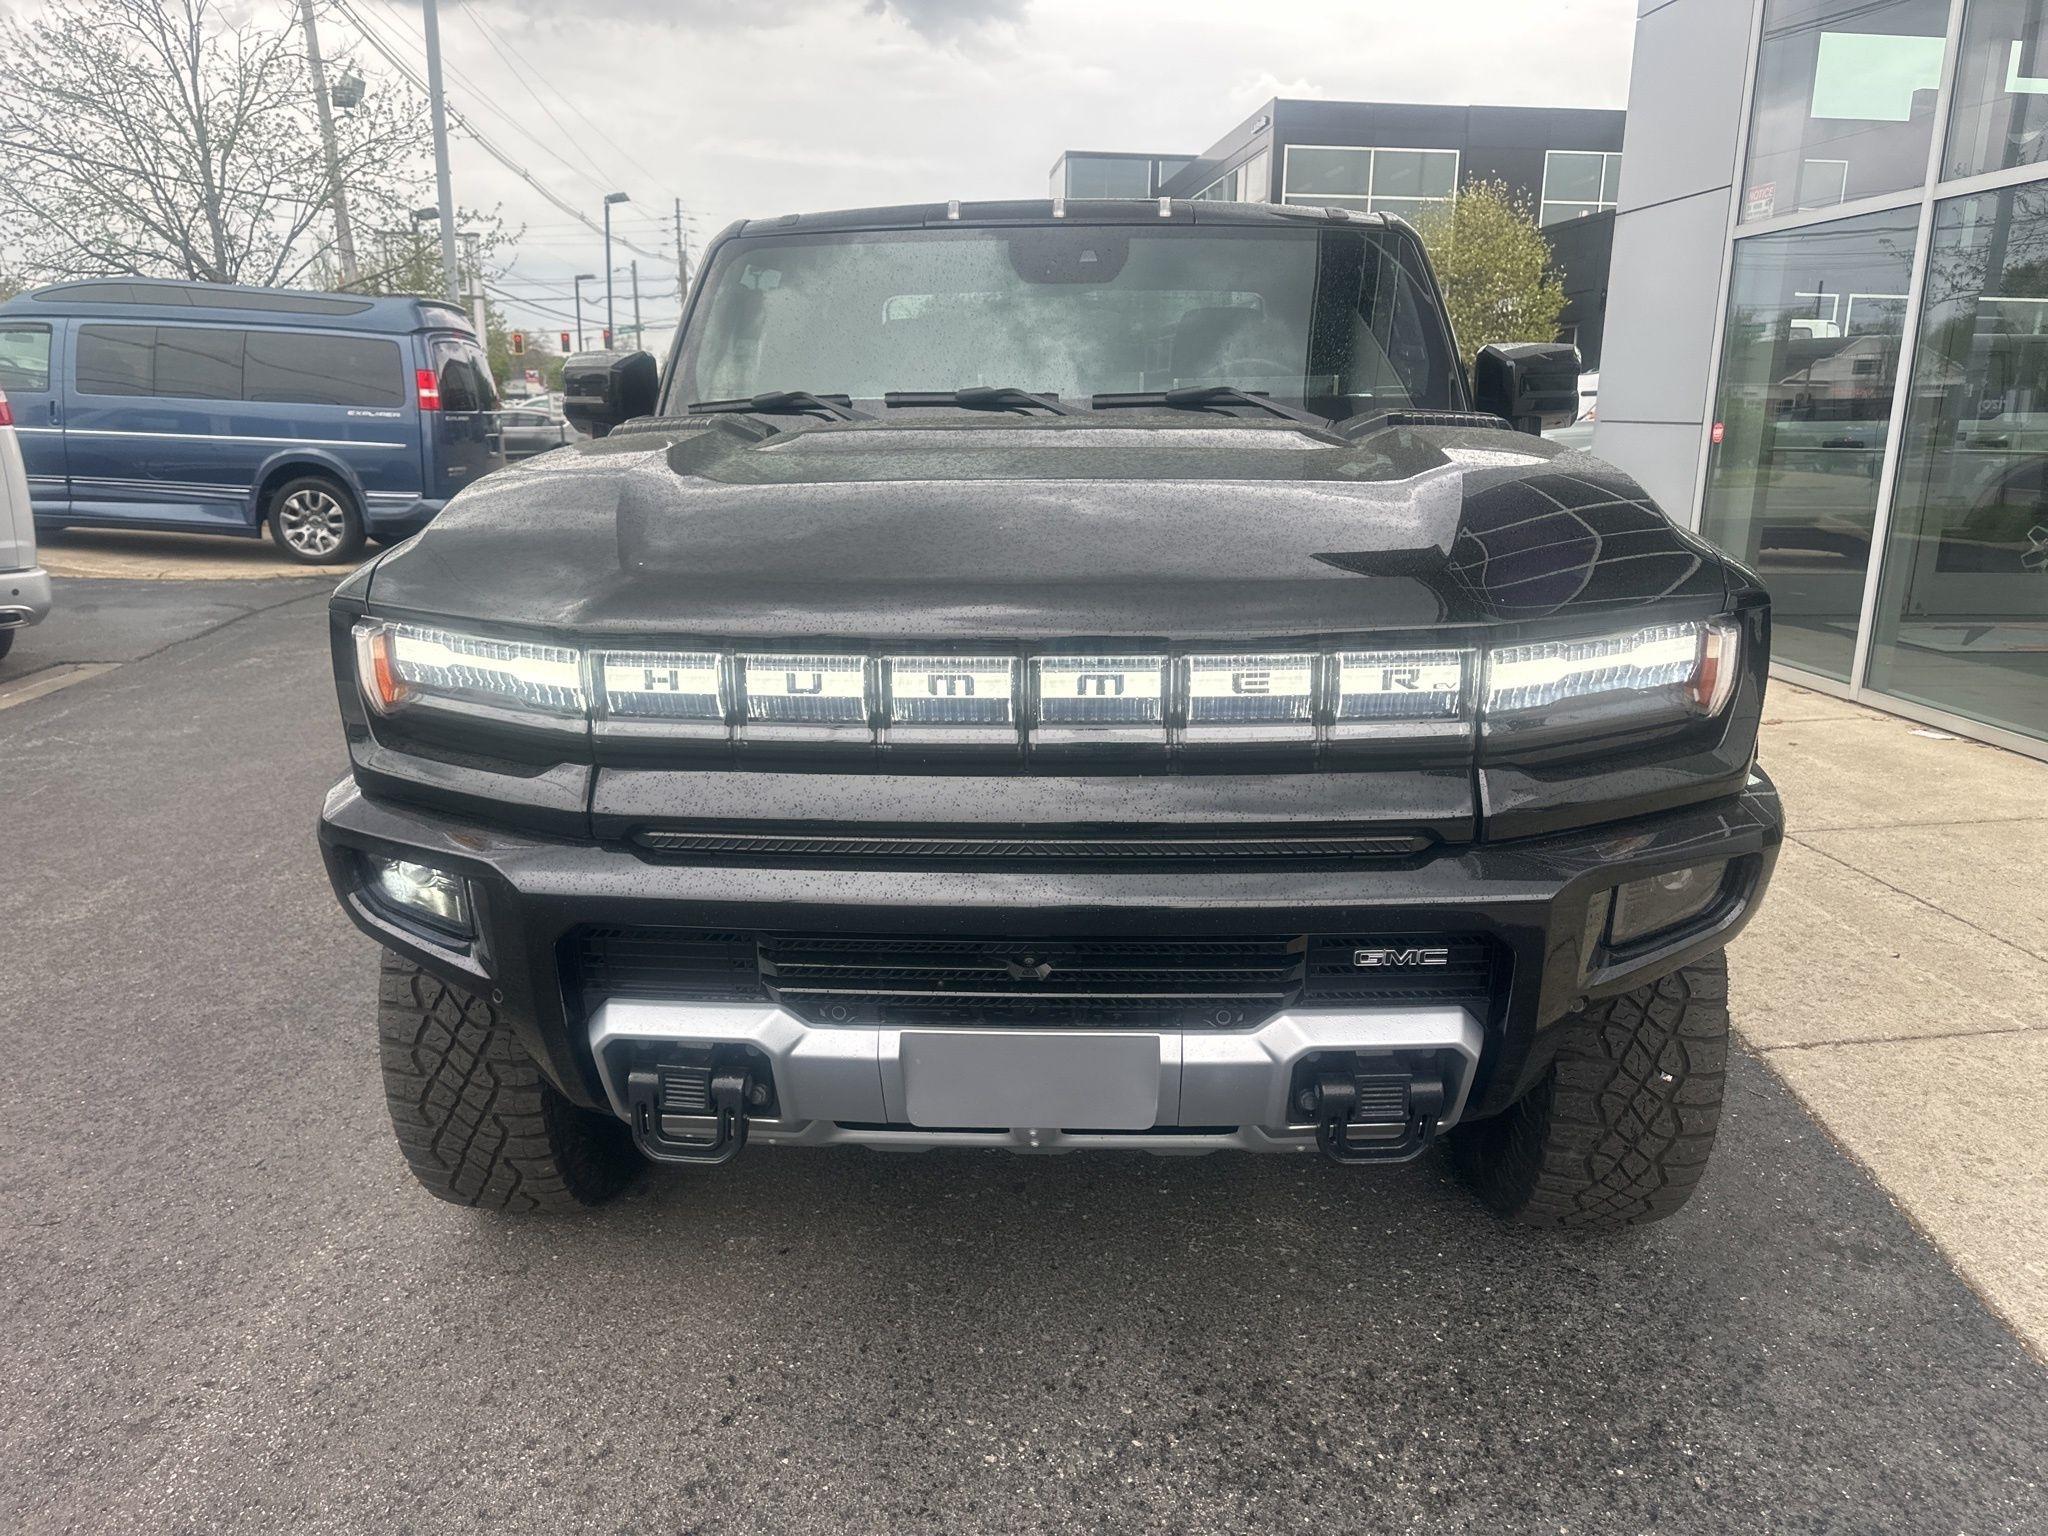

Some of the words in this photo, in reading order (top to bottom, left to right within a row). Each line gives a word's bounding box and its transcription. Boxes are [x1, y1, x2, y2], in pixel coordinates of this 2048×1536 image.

[1748, 186, 1775, 201] NOTICE
[644, 668, 1420, 696] HUMMER
[1353, 949, 1448, 966] GMC
